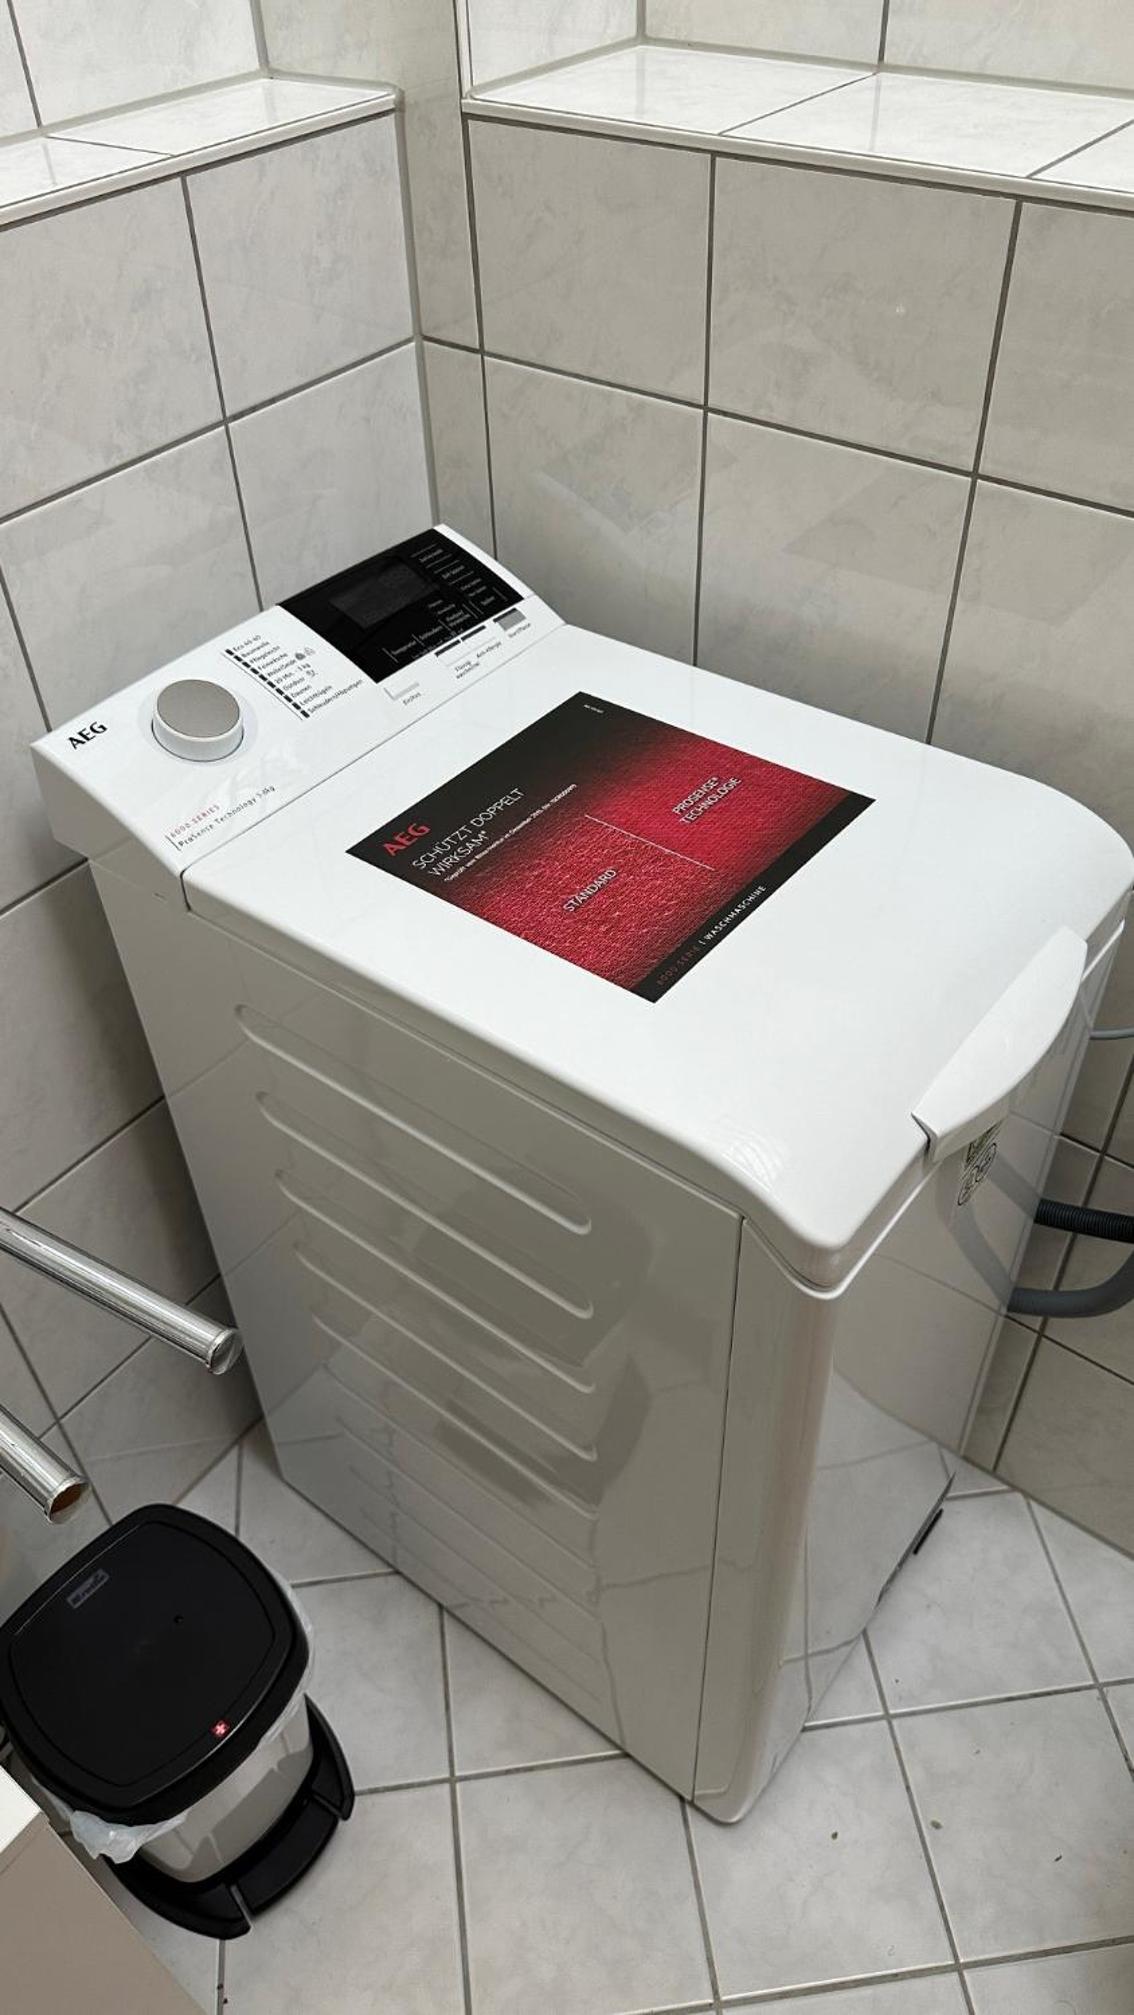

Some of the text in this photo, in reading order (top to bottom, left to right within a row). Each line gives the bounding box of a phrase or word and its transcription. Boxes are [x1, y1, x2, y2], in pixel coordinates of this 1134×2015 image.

[66, 720, 108, 751] AEG
[679, 778, 741, 823] TECHNOLOGIE
[384, 824, 430, 856] AEG
[412, 825, 472, 869] SCHÜTZT
[470, 788, 524, 827] DOPPELT
[563, 869, 616, 912] STANDARD
[704, 886, 766, 940] WASCHMASCHINE
